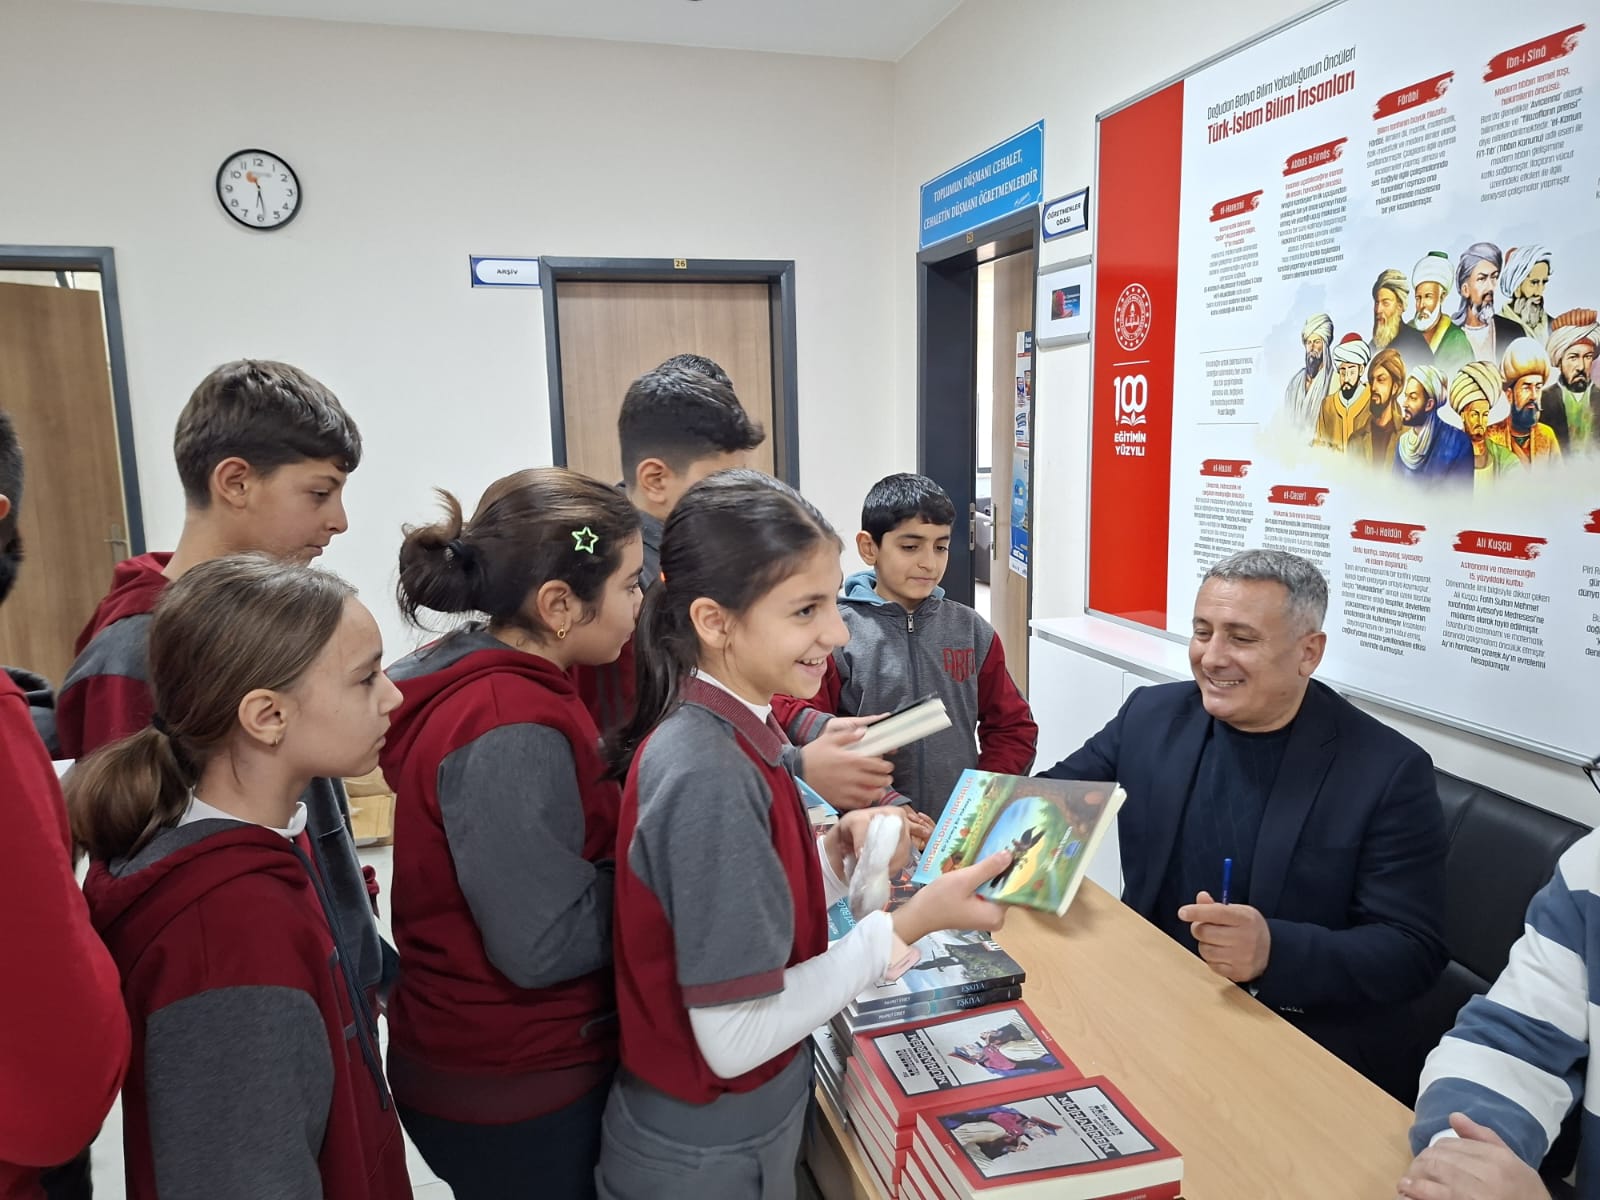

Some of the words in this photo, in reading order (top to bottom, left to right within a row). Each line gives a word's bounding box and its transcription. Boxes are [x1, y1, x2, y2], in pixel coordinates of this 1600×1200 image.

[1208, 98, 1234, 120] Doğudan
[1256, 82, 1272, 100] Bilim
[1274, 60, 1322, 93] Yolculuğunun
[1324, 44, 1356, 72] Öncüleri
[1495, 83, 1516, 96] Modern
[1563, 87, 1582, 99] olarak
[1208, 107, 1263, 144] Türk-İslam
[1266, 94, 1294, 123] Bilim
[1298, 70, 1355, 110] İnsanları
[241, 162, 246, 170] 11
[253, 158, 264, 166] 12
[272, 164, 276, 172] 1
[1291, 156, 1308, 170] Abbas
[280, 174, 288, 182] 2
[934, 178, 963, 202] TOPLUMUN
[964, 165, 992, 188] DÜŞMANI
[992, 149, 1022, 175] CEHALET,
[225, 184, 233, 192] 9
[231, 199, 238, 207] 8
[924, 207, 950, 230] CEHALETİN
[952, 196, 978, 218] DÜŞMANI
[979, 168, 1038, 206] ÖĞRETMENLERDİR
[282, 202, 288, 210] 4
[1047, 203, 1081, 220] ÖĞRETMENLER
[242, 208, 248, 217] 7
[257, 214, 264, 222] 6
[273, 211, 280, 219] 5
[1056, 217, 1071, 226] ODASI
[674, 260, 686, 268] 26
[496, 267, 518, 276] ARŞİV
[1114, 430, 1146, 443] EĞİTİMİN
[1115, 444, 1145, 456] YÜZYILI
[1476, 537, 1486, 548] Ali
[1488, 538, 1512, 552] Kuşçu
[1461, 561, 1488, 572] Astronomi
[1446, 579, 1475, 591] Döneminde
[1488, 586, 1512, 598] bilgisiyle
[1513, 590, 1530, 599] dikkat
[1532, 593, 1550, 604] çeken
[1448, 601, 1476, 612] tarafından
[1477, 606, 1502, 618] Ayasofya
[1480, 596, 1494, 604] Fatih
[1495, 598, 1513, 608] Sultan
[1514, 601, 1539, 612] Mehmet
[1477, 616, 1493, 626] olarak
[1494, 619, 1508, 630] tayin
[1475, 625, 1502, 638] astronomi
[1512, 632, 1543, 646] matematik
[1482, 648, 1501, 660] çizerek
[924, 816, 952, 872] MASALDAN
[951, 777, 973, 815] MASALA
[957, 997, 980, 1007] EŞKIYA
[910, 1034, 948, 1085] MUHARREM
[1058, 1097, 1115, 1153] MUHARREM
